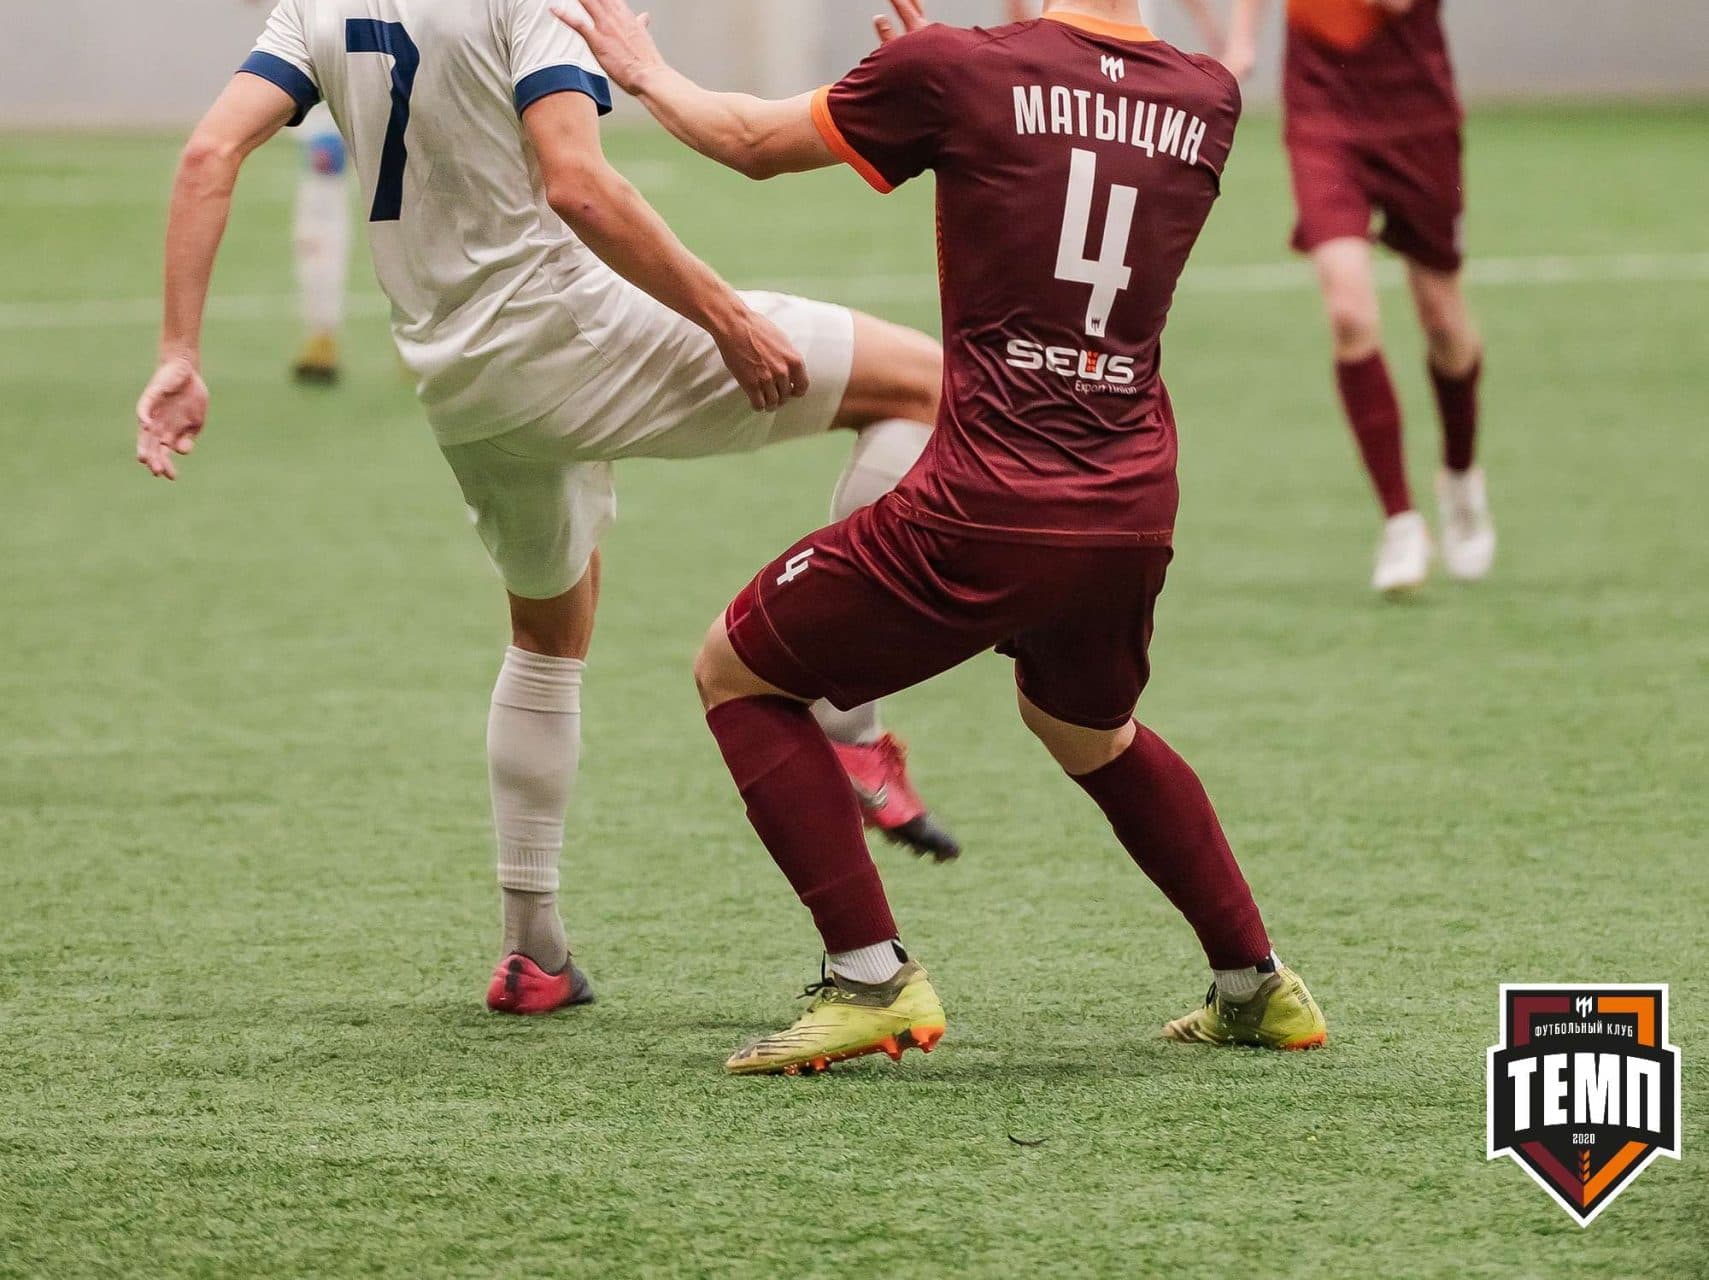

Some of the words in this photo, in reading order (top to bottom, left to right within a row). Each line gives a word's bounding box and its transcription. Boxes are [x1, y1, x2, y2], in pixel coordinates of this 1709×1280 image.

[345, 18, 420, 222] 7
[1012, 84, 1207, 165] МАТЫЦИН
[1054, 147, 1138, 338] 4
[1006, 339, 1135, 384] SEUS
[776, 547, 814, 586] 4
